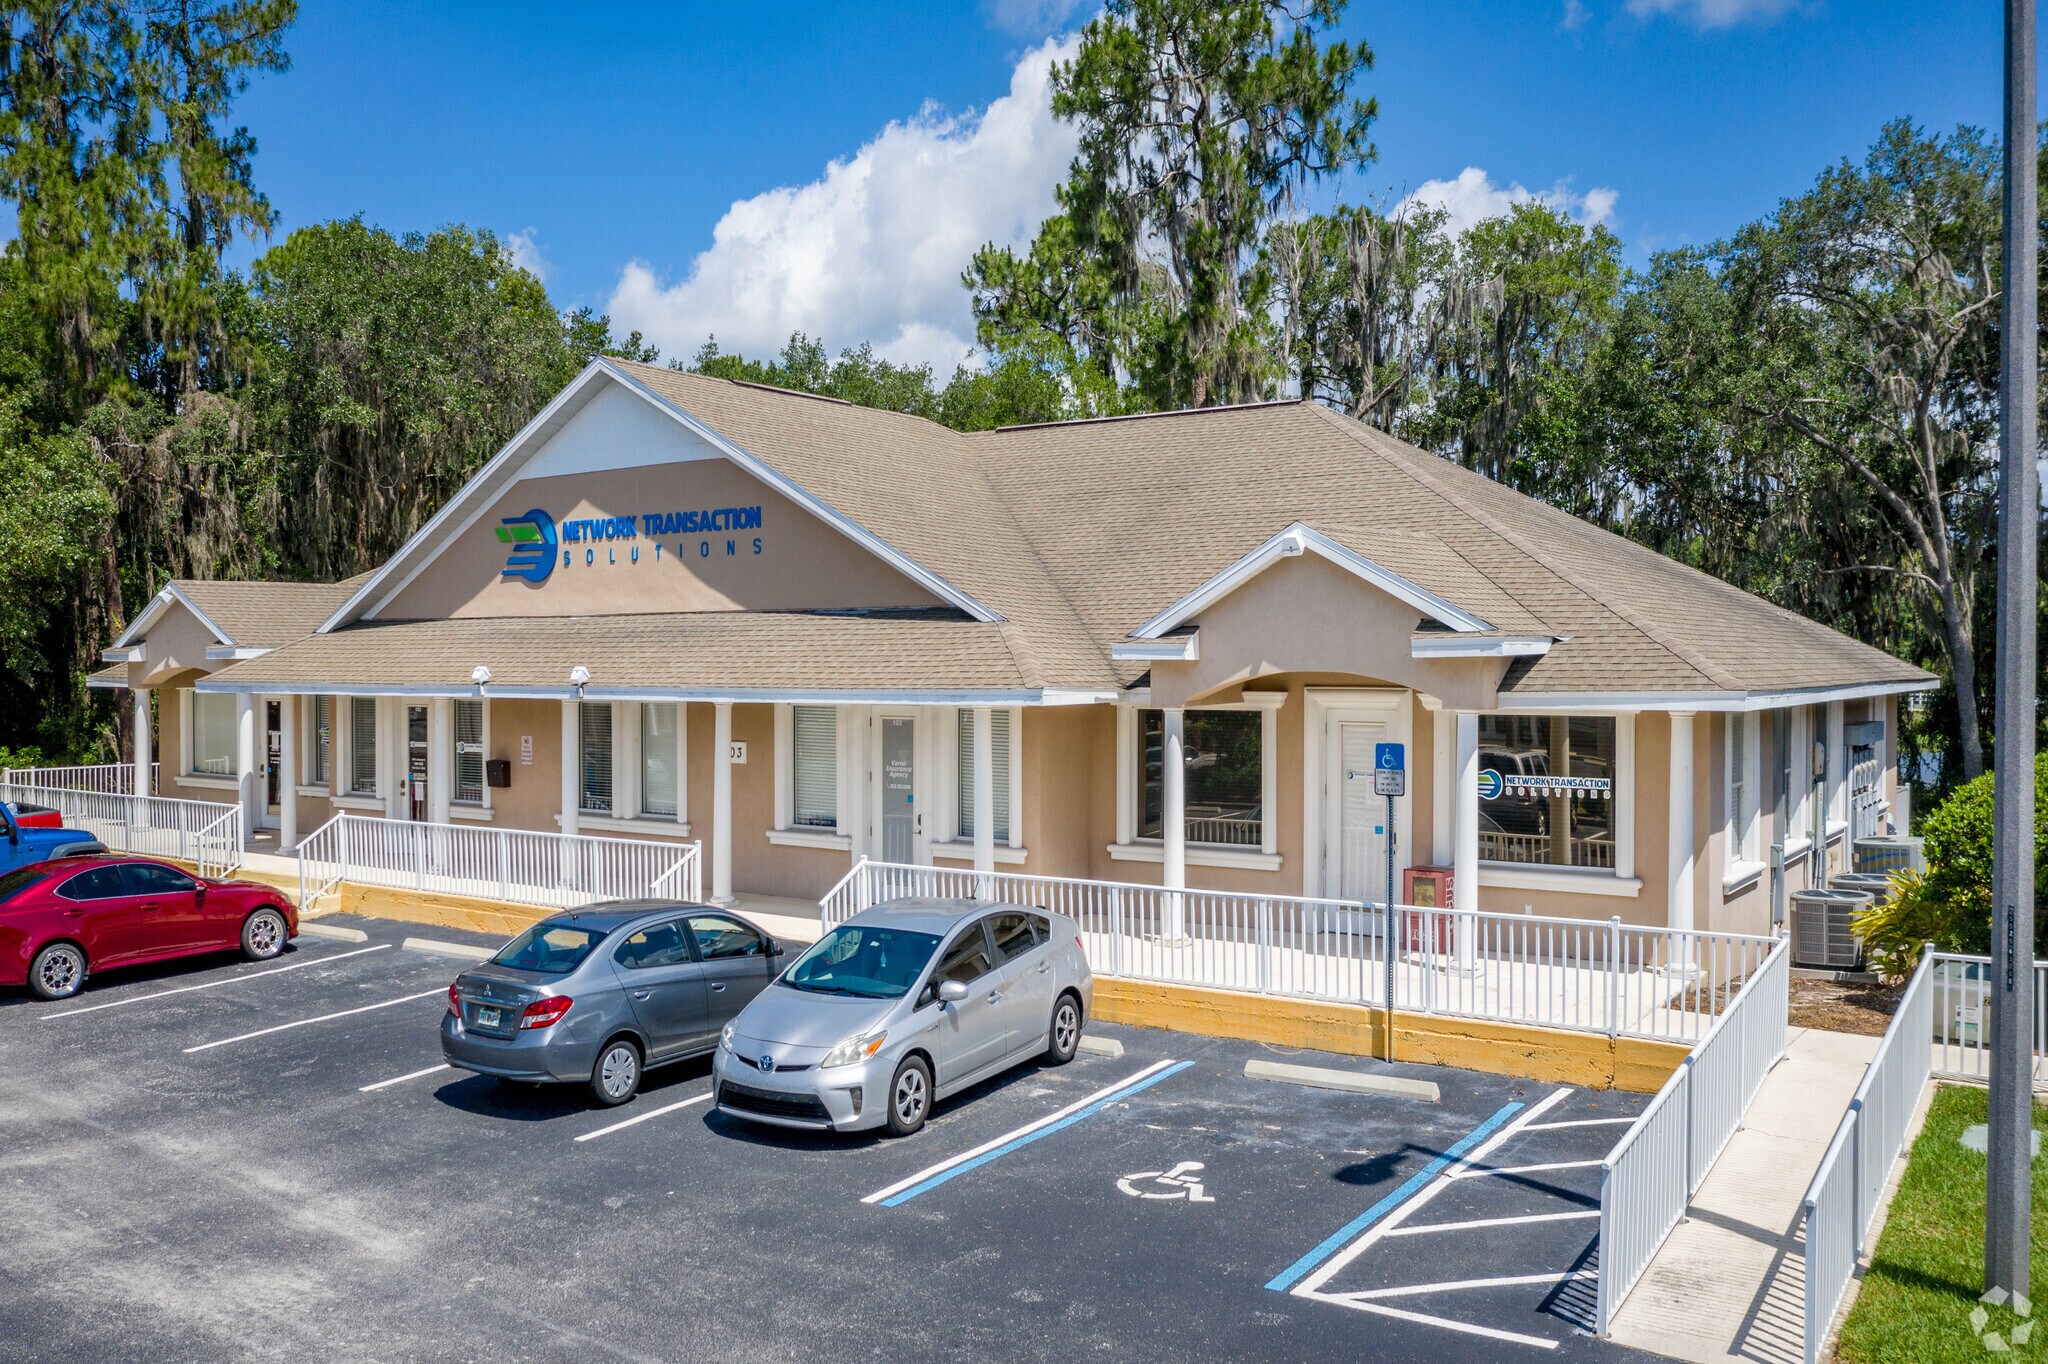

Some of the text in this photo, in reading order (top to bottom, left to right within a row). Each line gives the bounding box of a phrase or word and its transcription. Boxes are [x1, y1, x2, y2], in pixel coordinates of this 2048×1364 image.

[562, 506, 762, 542] NETWORK TRANSACTION
[563, 538, 762, 565] SOLUTIONS
[730, 746, 743, 759] 03
[886, 765, 912, 773] Insurance
[889, 771, 909, 779] Agency
[1506, 776, 1609, 788] NETWORK TRANSACTION
[1505, 787, 1611, 799] SOLUTIONS
